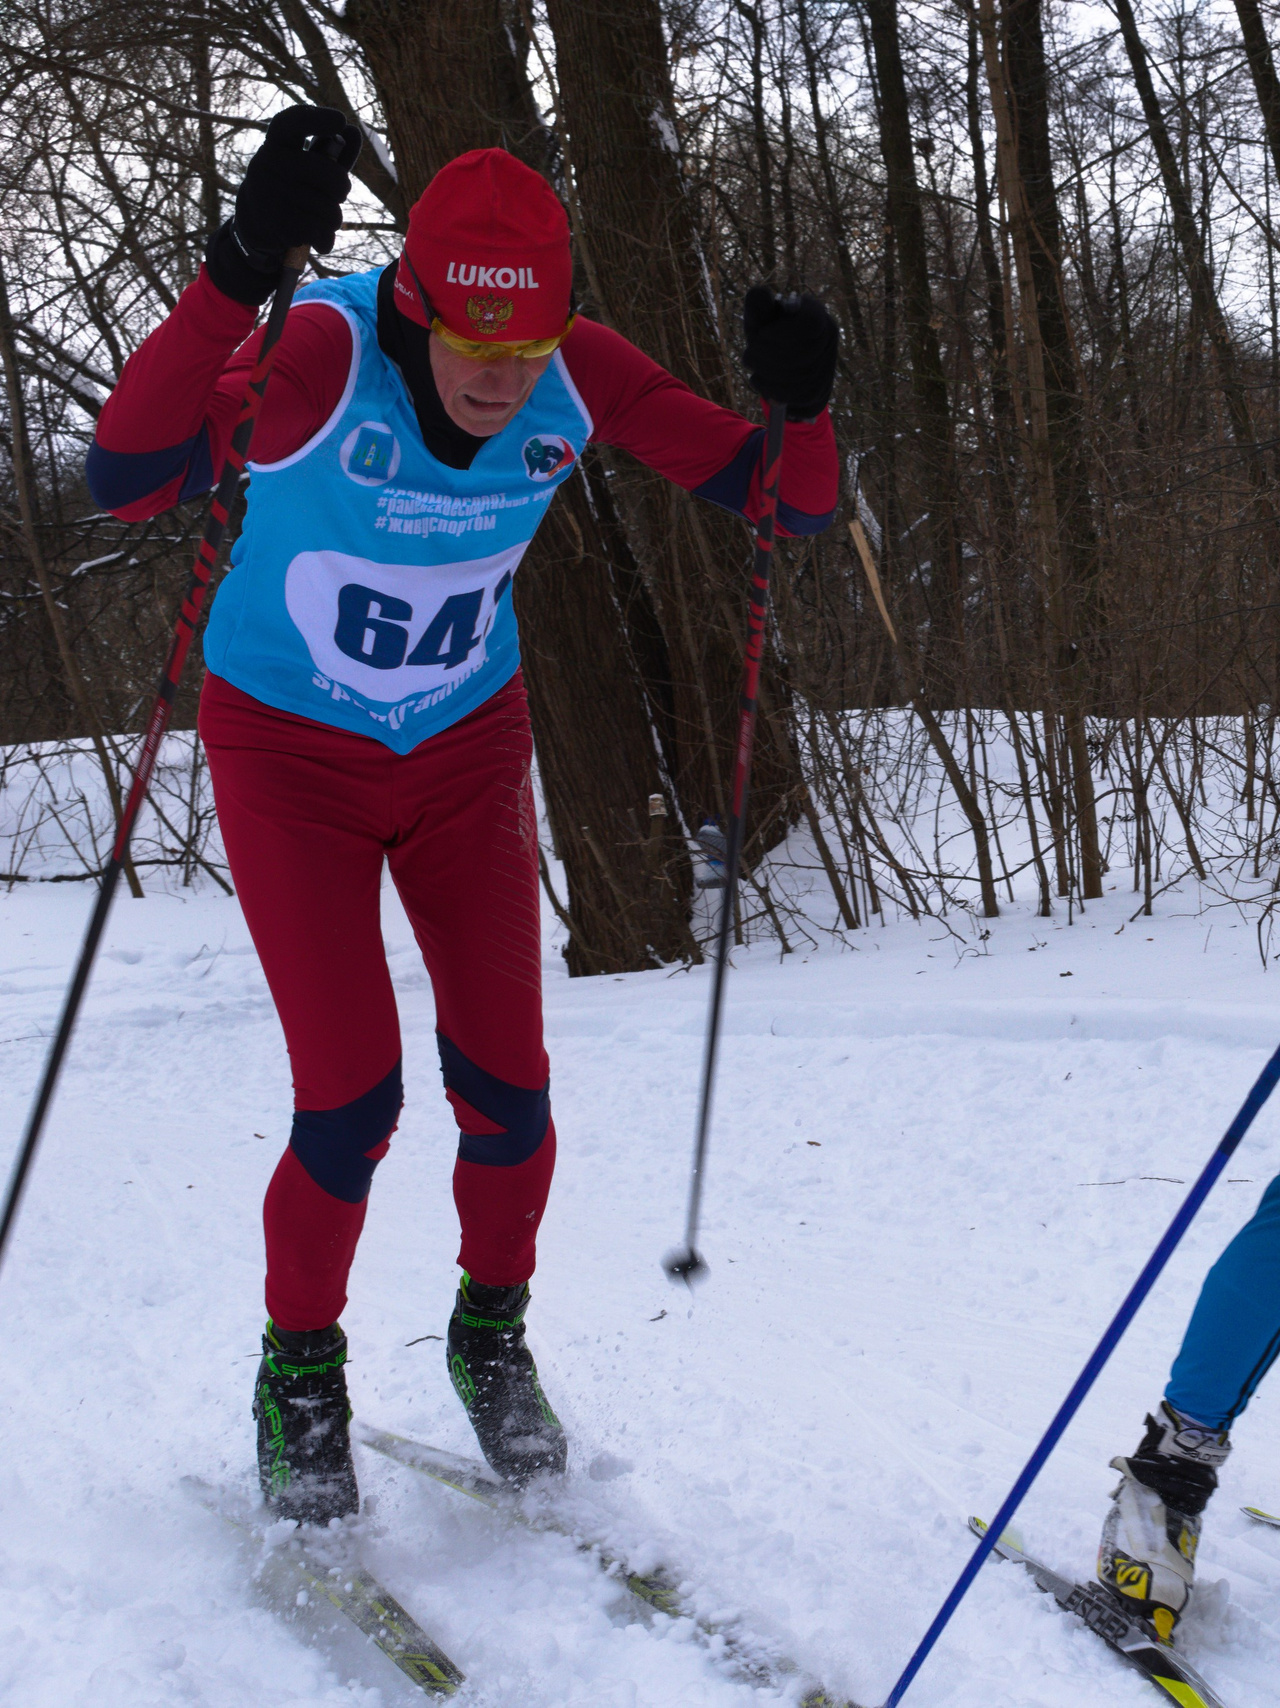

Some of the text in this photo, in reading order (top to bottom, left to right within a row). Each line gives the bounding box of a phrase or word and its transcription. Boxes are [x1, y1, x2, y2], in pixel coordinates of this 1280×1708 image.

[446, 261, 539, 289] LUKOIL
[462, 1311, 526, 1331] SPINE
[282, 1351, 347, 1377] SPINE
